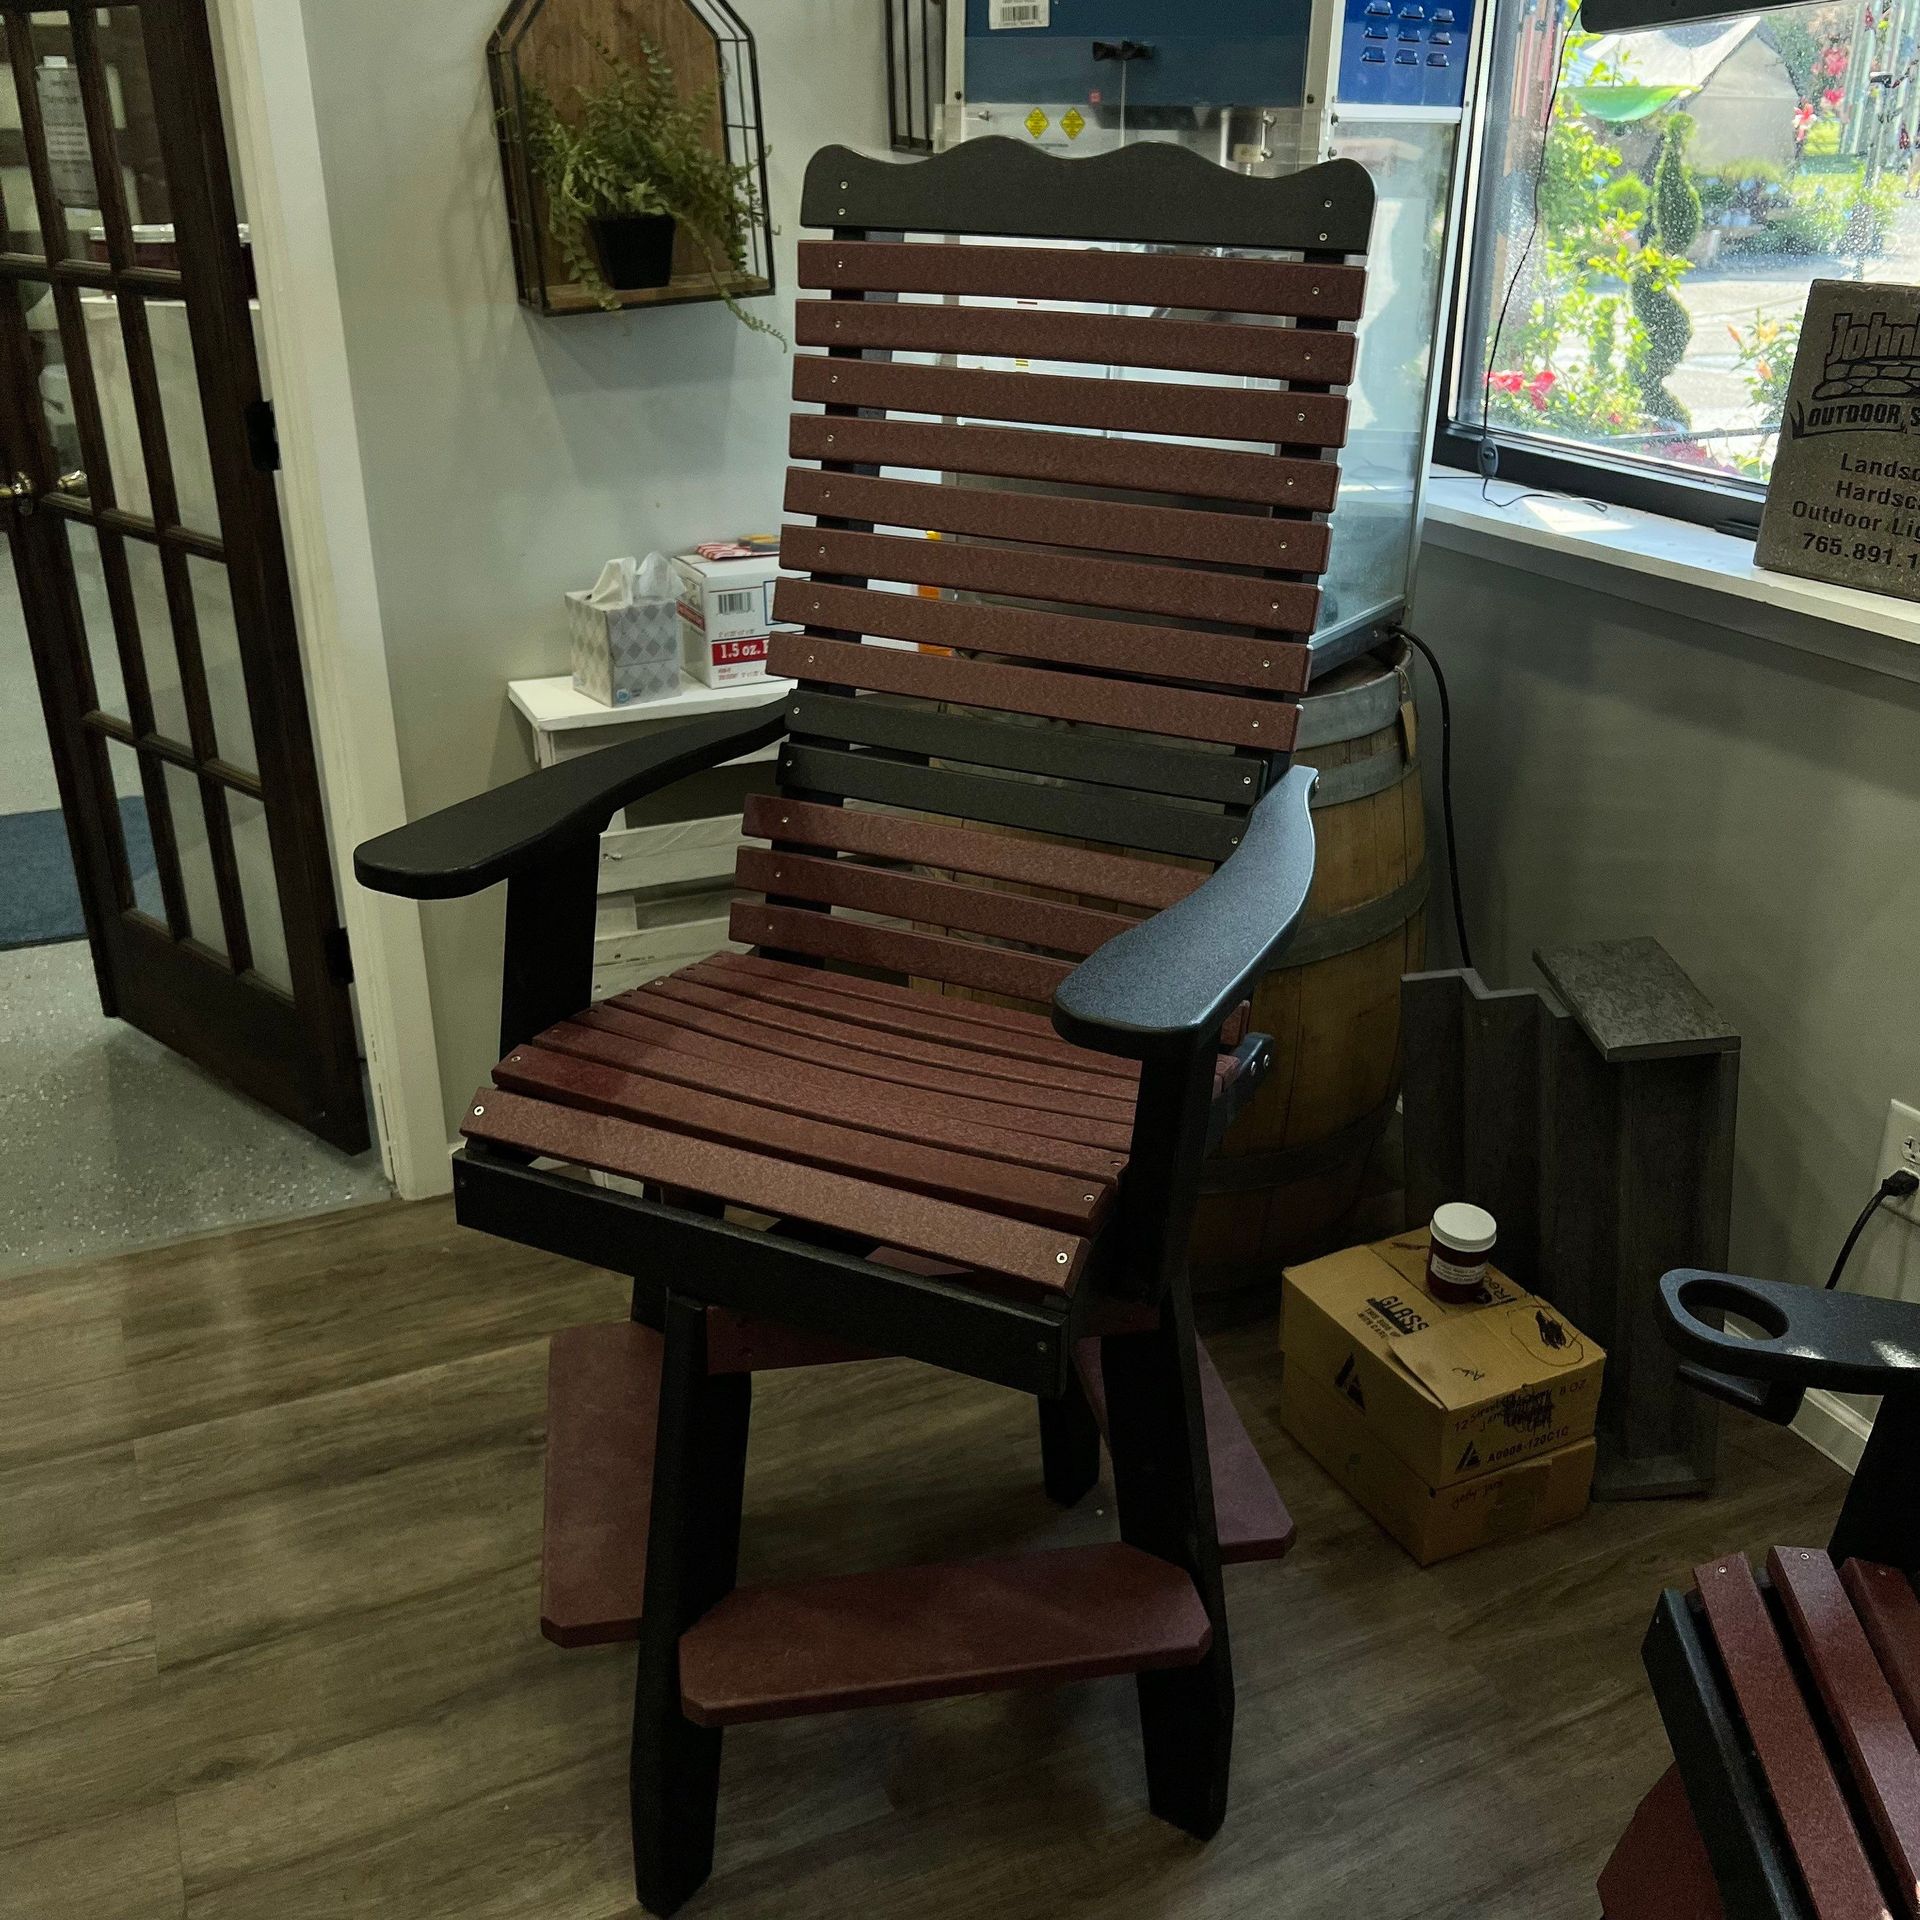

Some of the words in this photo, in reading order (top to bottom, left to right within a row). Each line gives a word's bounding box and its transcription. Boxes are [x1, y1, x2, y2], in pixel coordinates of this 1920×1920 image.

[1825, 312, 1920, 363] John
[1808, 403, 1901, 428] OUTDOOR
[1835, 480, 1920, 510] Hardsc
[1792, 500, 1882, 532] Outdoor
[1803, 532, 1919, 570] 765.891.1
[720, 643, 740, 659] 1.5
[742, 644, 765, 656] oz.
[1378, 1295, 1430, 1332] GLASS
